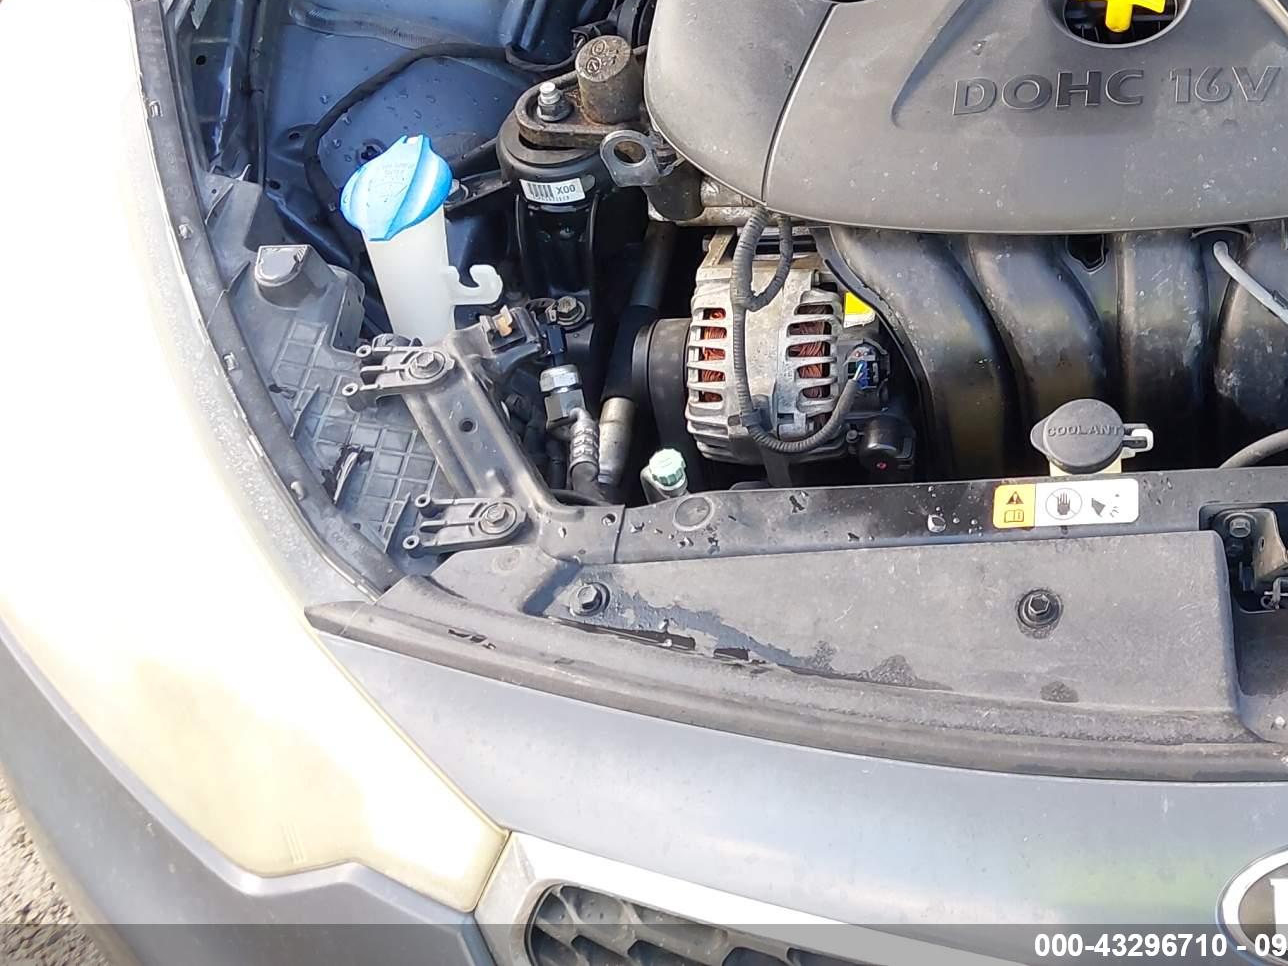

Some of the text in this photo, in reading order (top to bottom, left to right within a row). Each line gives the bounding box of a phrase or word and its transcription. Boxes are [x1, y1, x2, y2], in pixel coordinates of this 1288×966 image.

[953, 65, 1281, 115] DOHC 16V
[1048, 425, 1121, 438] COOLANT
